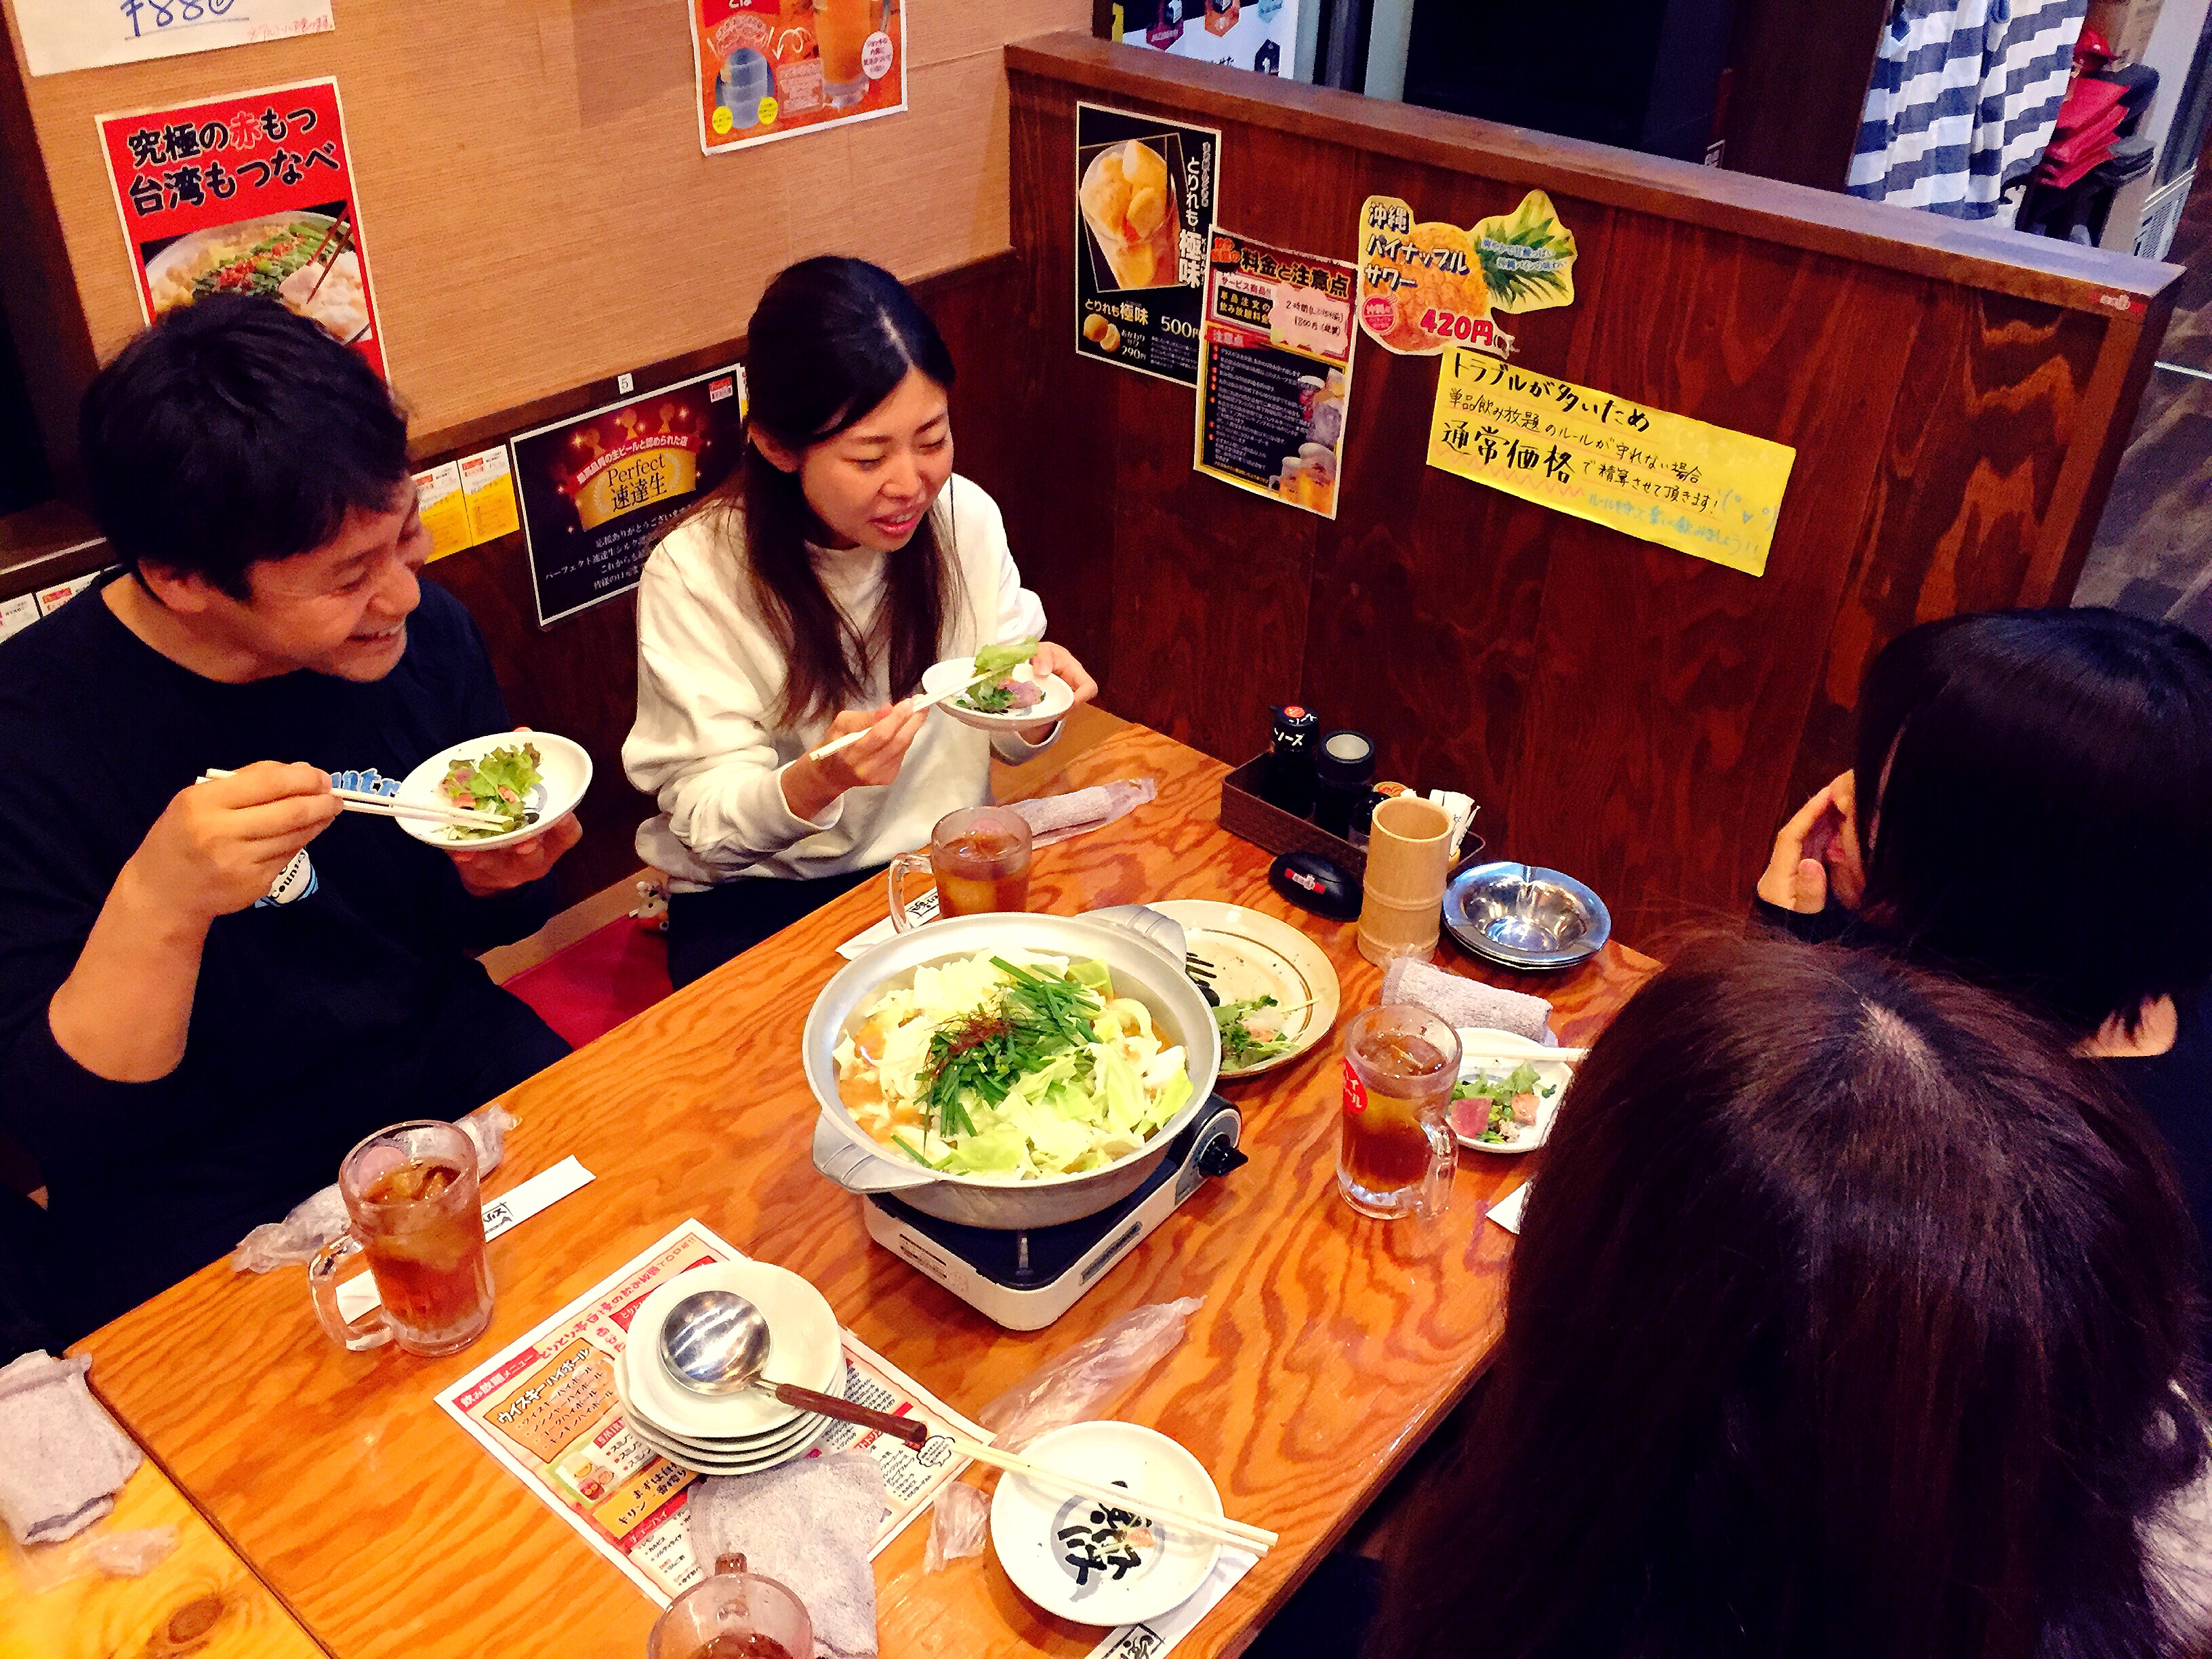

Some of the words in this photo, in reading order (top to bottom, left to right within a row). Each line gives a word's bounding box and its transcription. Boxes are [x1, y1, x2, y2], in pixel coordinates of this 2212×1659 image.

[127, 106, 318, 168] 究極の赤もつ
[129, 141, 341, 217] 台湾もつなべ
[1368, 201, 1410, 234] 沖縄
[1366, 234, 1470, 275] パイナップル
[1365, 265, 1418, 291] サワー
[1420, 309, 1493, 346] 420円
[621, 377, 629, 390] 5
[1454, 350, 1651, 433] トラブルが多いため
[607, 453, 665, 488] Perfect
[1441, 419, 1577, 485] 通常価格
[611, 472, 668, 512] 速達生
[1274, 727, 1305, 746] ソース
